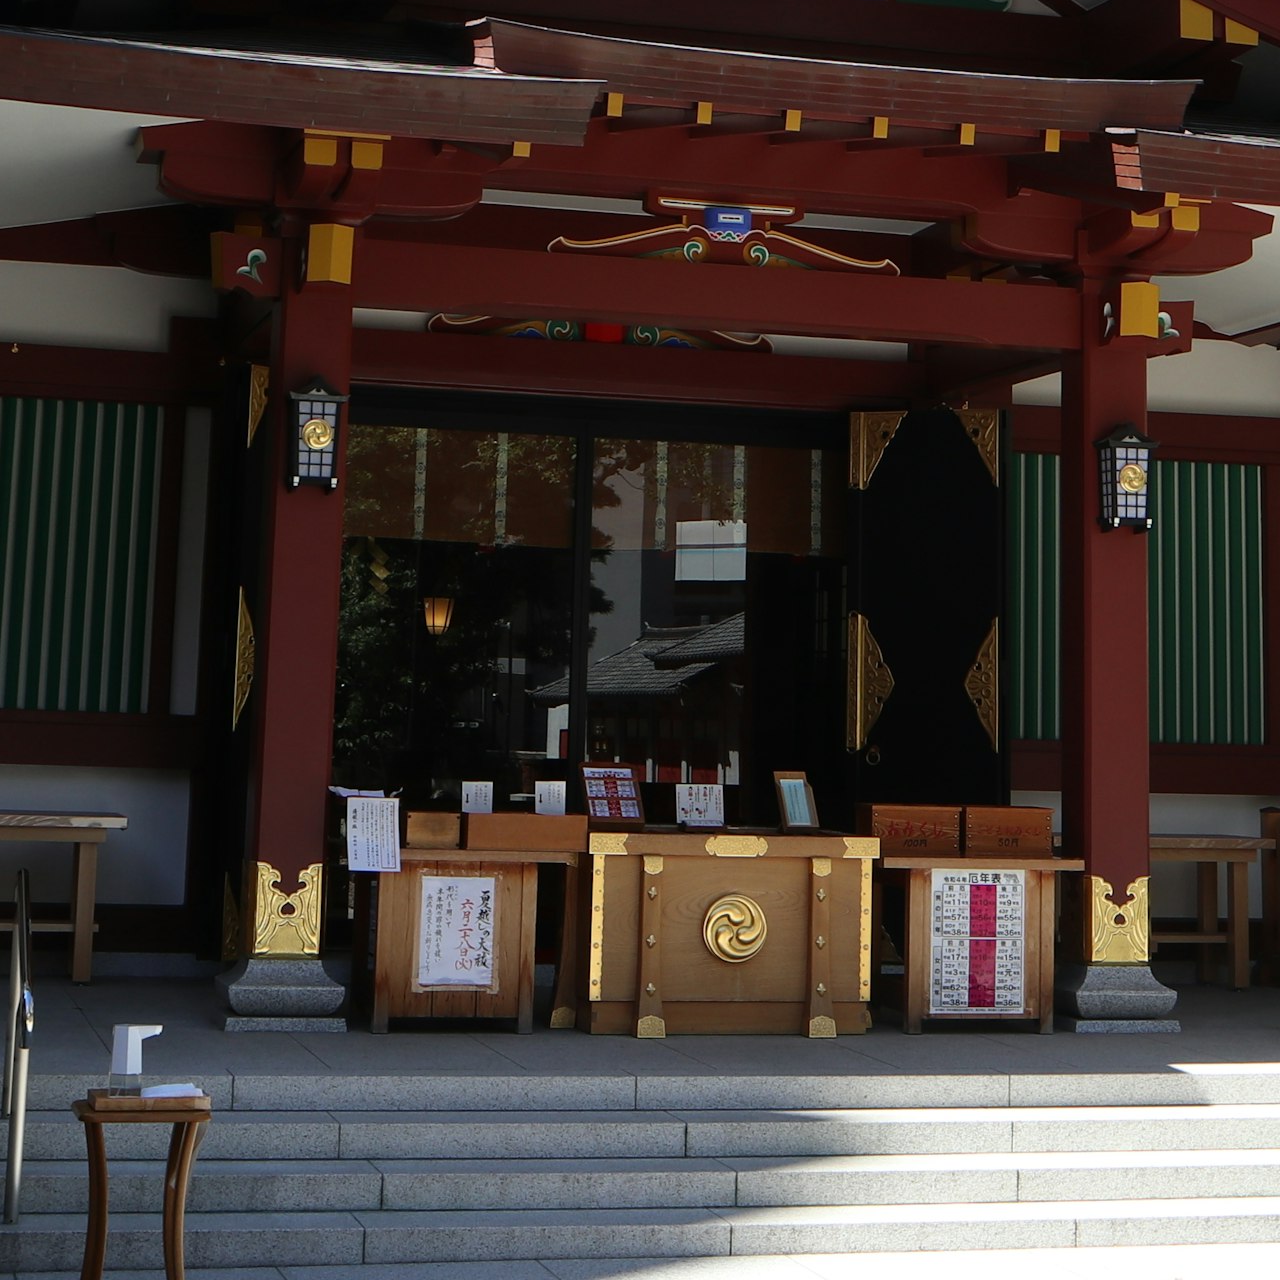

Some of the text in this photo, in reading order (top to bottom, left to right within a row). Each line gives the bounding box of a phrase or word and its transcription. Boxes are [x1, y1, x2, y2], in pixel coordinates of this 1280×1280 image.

[887, 820, 945, 838] おみくじ
[903, 838, 928, 848] 100円
[998, 838, 1020, 848] 50円
[969, 873, 1002, 883] 厄年表
[474, 890, 492, 969] 夏越しの大祓
